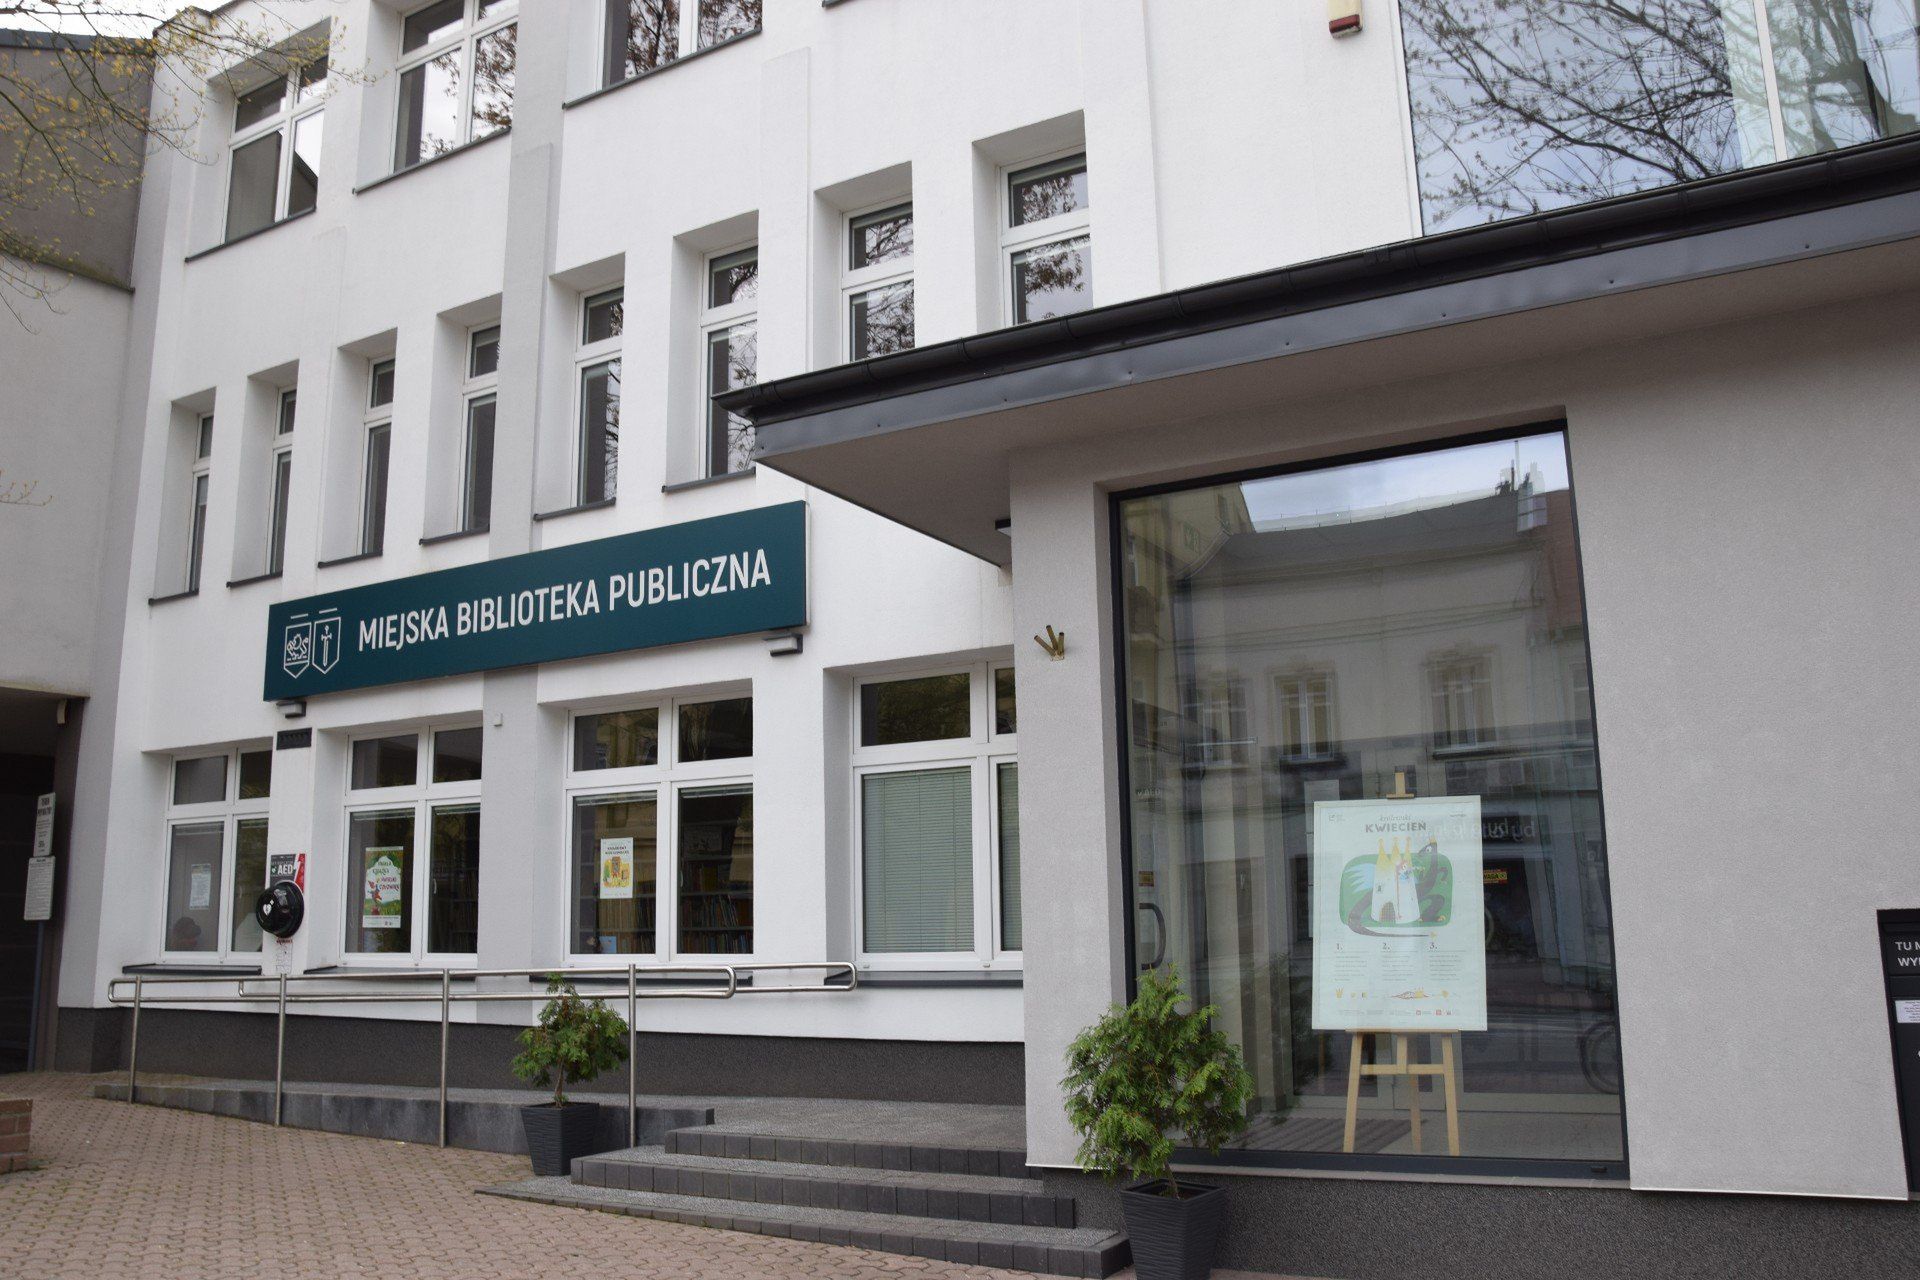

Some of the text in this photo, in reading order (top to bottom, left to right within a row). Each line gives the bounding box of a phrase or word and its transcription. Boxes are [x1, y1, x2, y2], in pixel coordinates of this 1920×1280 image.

[358, 548, 771, 652] MIEJSKA BIBLIOTEKA PUBLICZNA
[277, 864, 293, 875] AED
[1894, 941, 1911, 951] TU
[1897, 957, 1920, 967] WY
